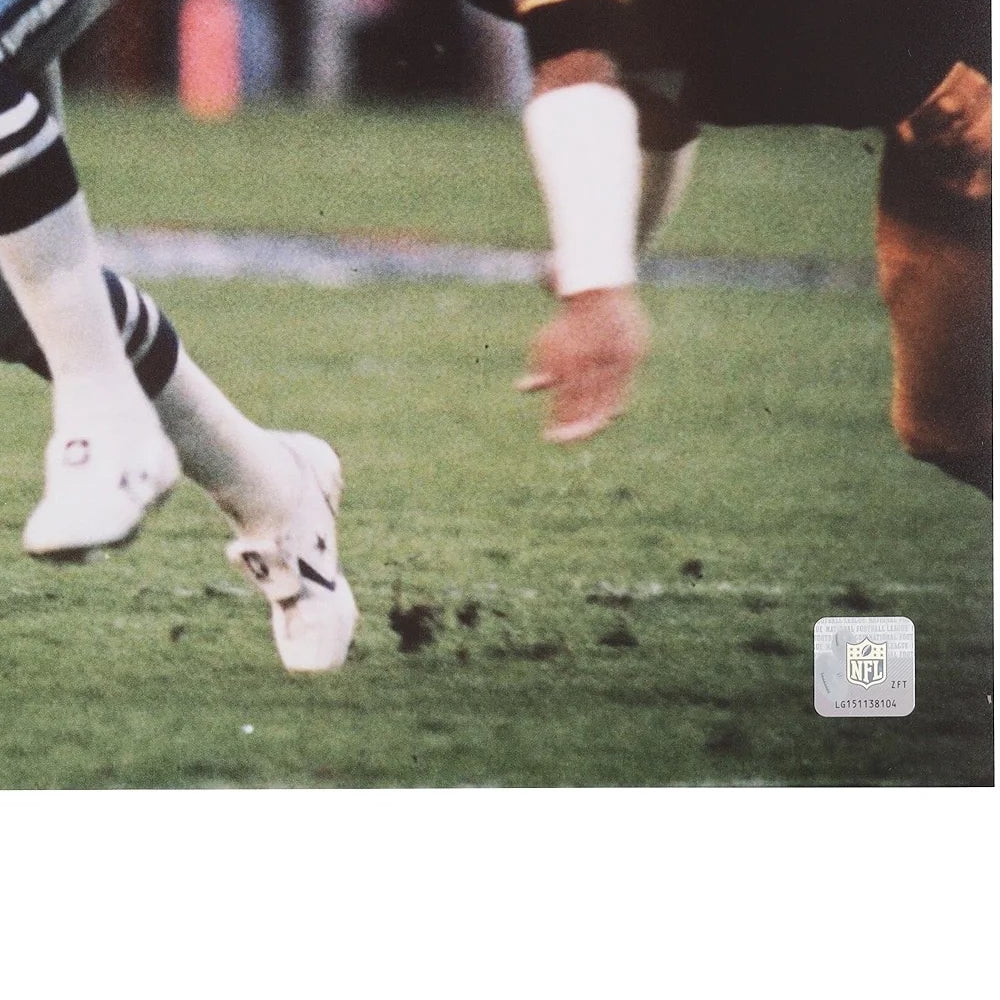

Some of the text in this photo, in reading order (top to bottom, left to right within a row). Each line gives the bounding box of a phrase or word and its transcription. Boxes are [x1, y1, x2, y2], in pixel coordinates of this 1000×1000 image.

[851, 660, 883, 685] NFL
[890, 680, 908, 690] ZFT
[835, 699, 897, 710] LG151138104
